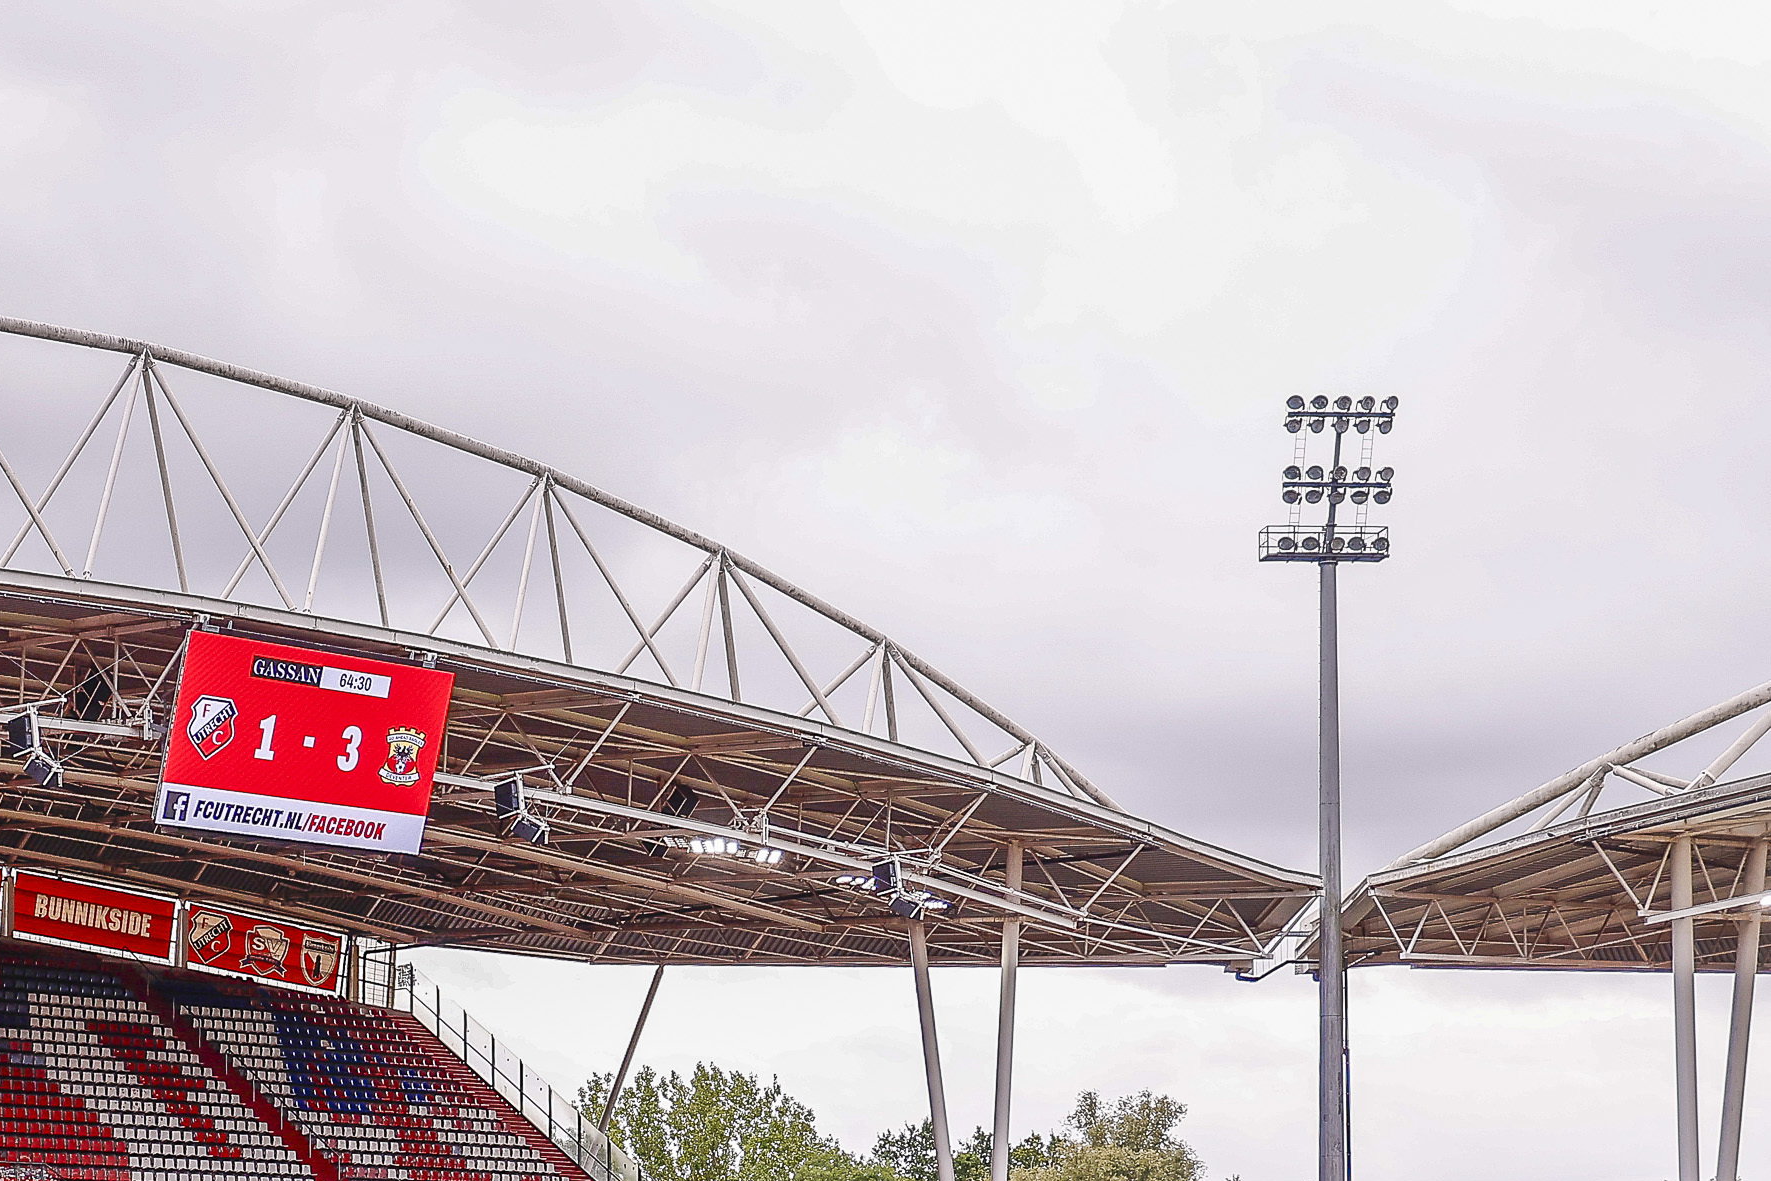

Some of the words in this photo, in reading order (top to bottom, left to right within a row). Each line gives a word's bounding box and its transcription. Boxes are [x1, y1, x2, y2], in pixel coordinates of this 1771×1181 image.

[253, 658, 321, 684] GASSAN
[339, 676, 372, 692] 64:30
[193, 704, 233, 744] UTRECHT
[253, 714, 277, 761] 1
[336, 725, 363, 772] 3
[192, 800, 387, 841] FCUTRECHT.NL/FACEBOOK
[35, 892, 153, 939] BUNNIKSIDE
[194, 919, 229, 950] UTRECHT
